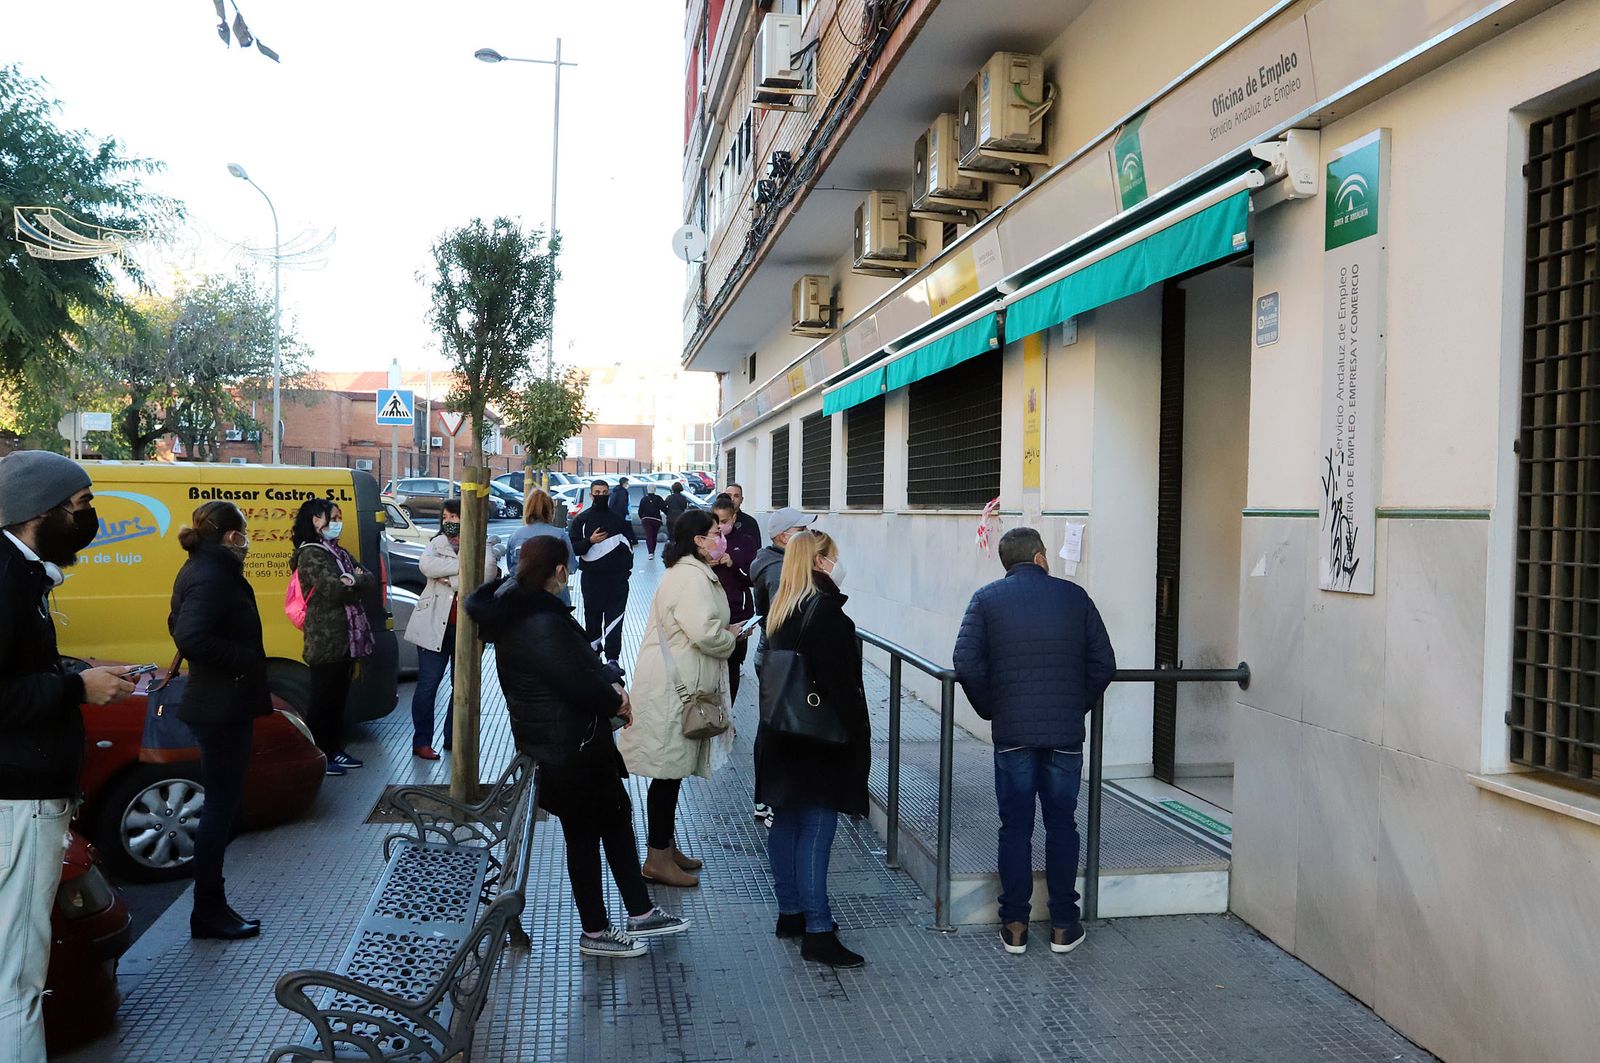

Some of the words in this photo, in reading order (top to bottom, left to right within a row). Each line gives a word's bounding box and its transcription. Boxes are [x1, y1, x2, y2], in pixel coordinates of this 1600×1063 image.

[1212, 88, 1244, 118] Oficina
[1245, 76, 1258, 97] de
[1258, 52, 1298, 89] Empleo
[1209, 119, 1233, 141] Servicio
[1234, 102, 1261, 125] Andaluz
[1262, 95, 1272, 109] de
[1273, 78, 1301, 102] Empleo
[1338, 267, 1348, 320] Empleo
[1350, 263, 1360, 334] COMERCIO
[1337, 323, 1346, 341] de
[1350, 337, 1358, 346] Y
[1336, 344, 1346, 401] Andaluz
[1349, 347, 1357, 407] EMPRESA
[1335, 405, 1344, 457] Servicio
[188, 487, 260, 501] Baltasar
[326, 489, 352, 502] S.L.
[1346, 469, 1355, 488] DE
[94, 552, 112, 563] de
[116, 552, 142, 565] lujo
[255, 570, 271, 578] 959
[274, 570, 284, 578] 15
[267, 560, 289, 569] Baja)
